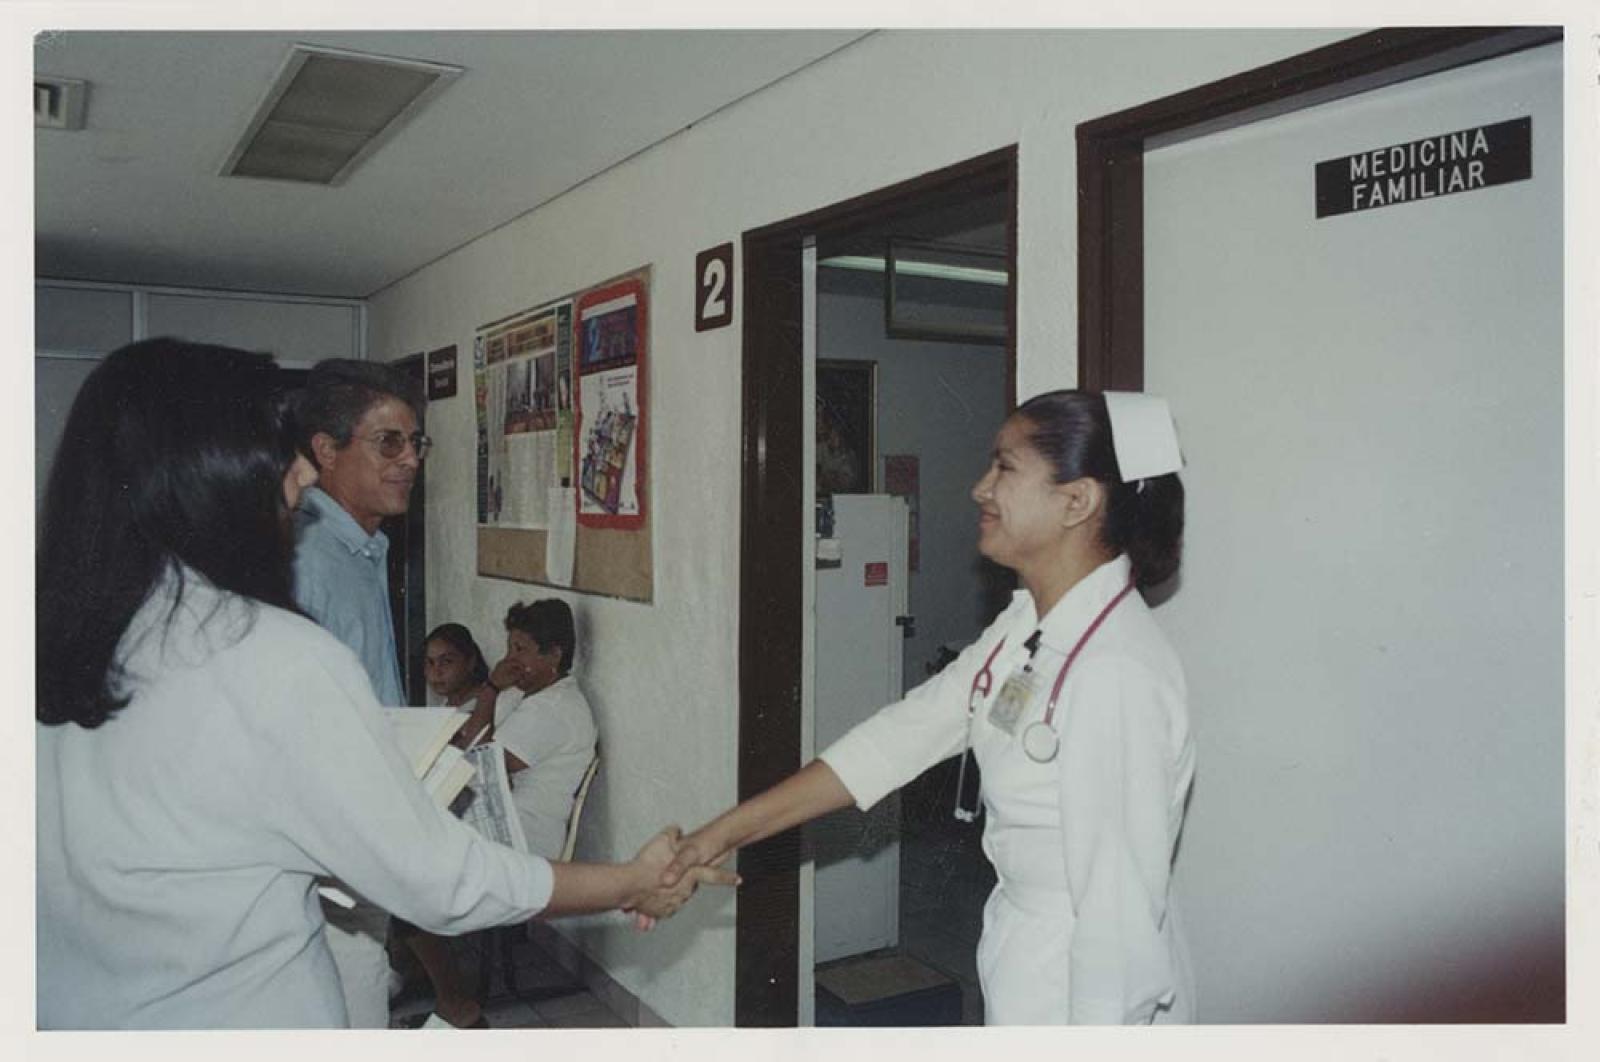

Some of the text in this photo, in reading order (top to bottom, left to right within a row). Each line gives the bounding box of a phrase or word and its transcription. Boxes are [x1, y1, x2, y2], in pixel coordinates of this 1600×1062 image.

[1350, 128, 1489, 181] MEDICINA
[1353, 160, 1485, 210] FAMILIAR
[703, 258, 726, 319] 2
